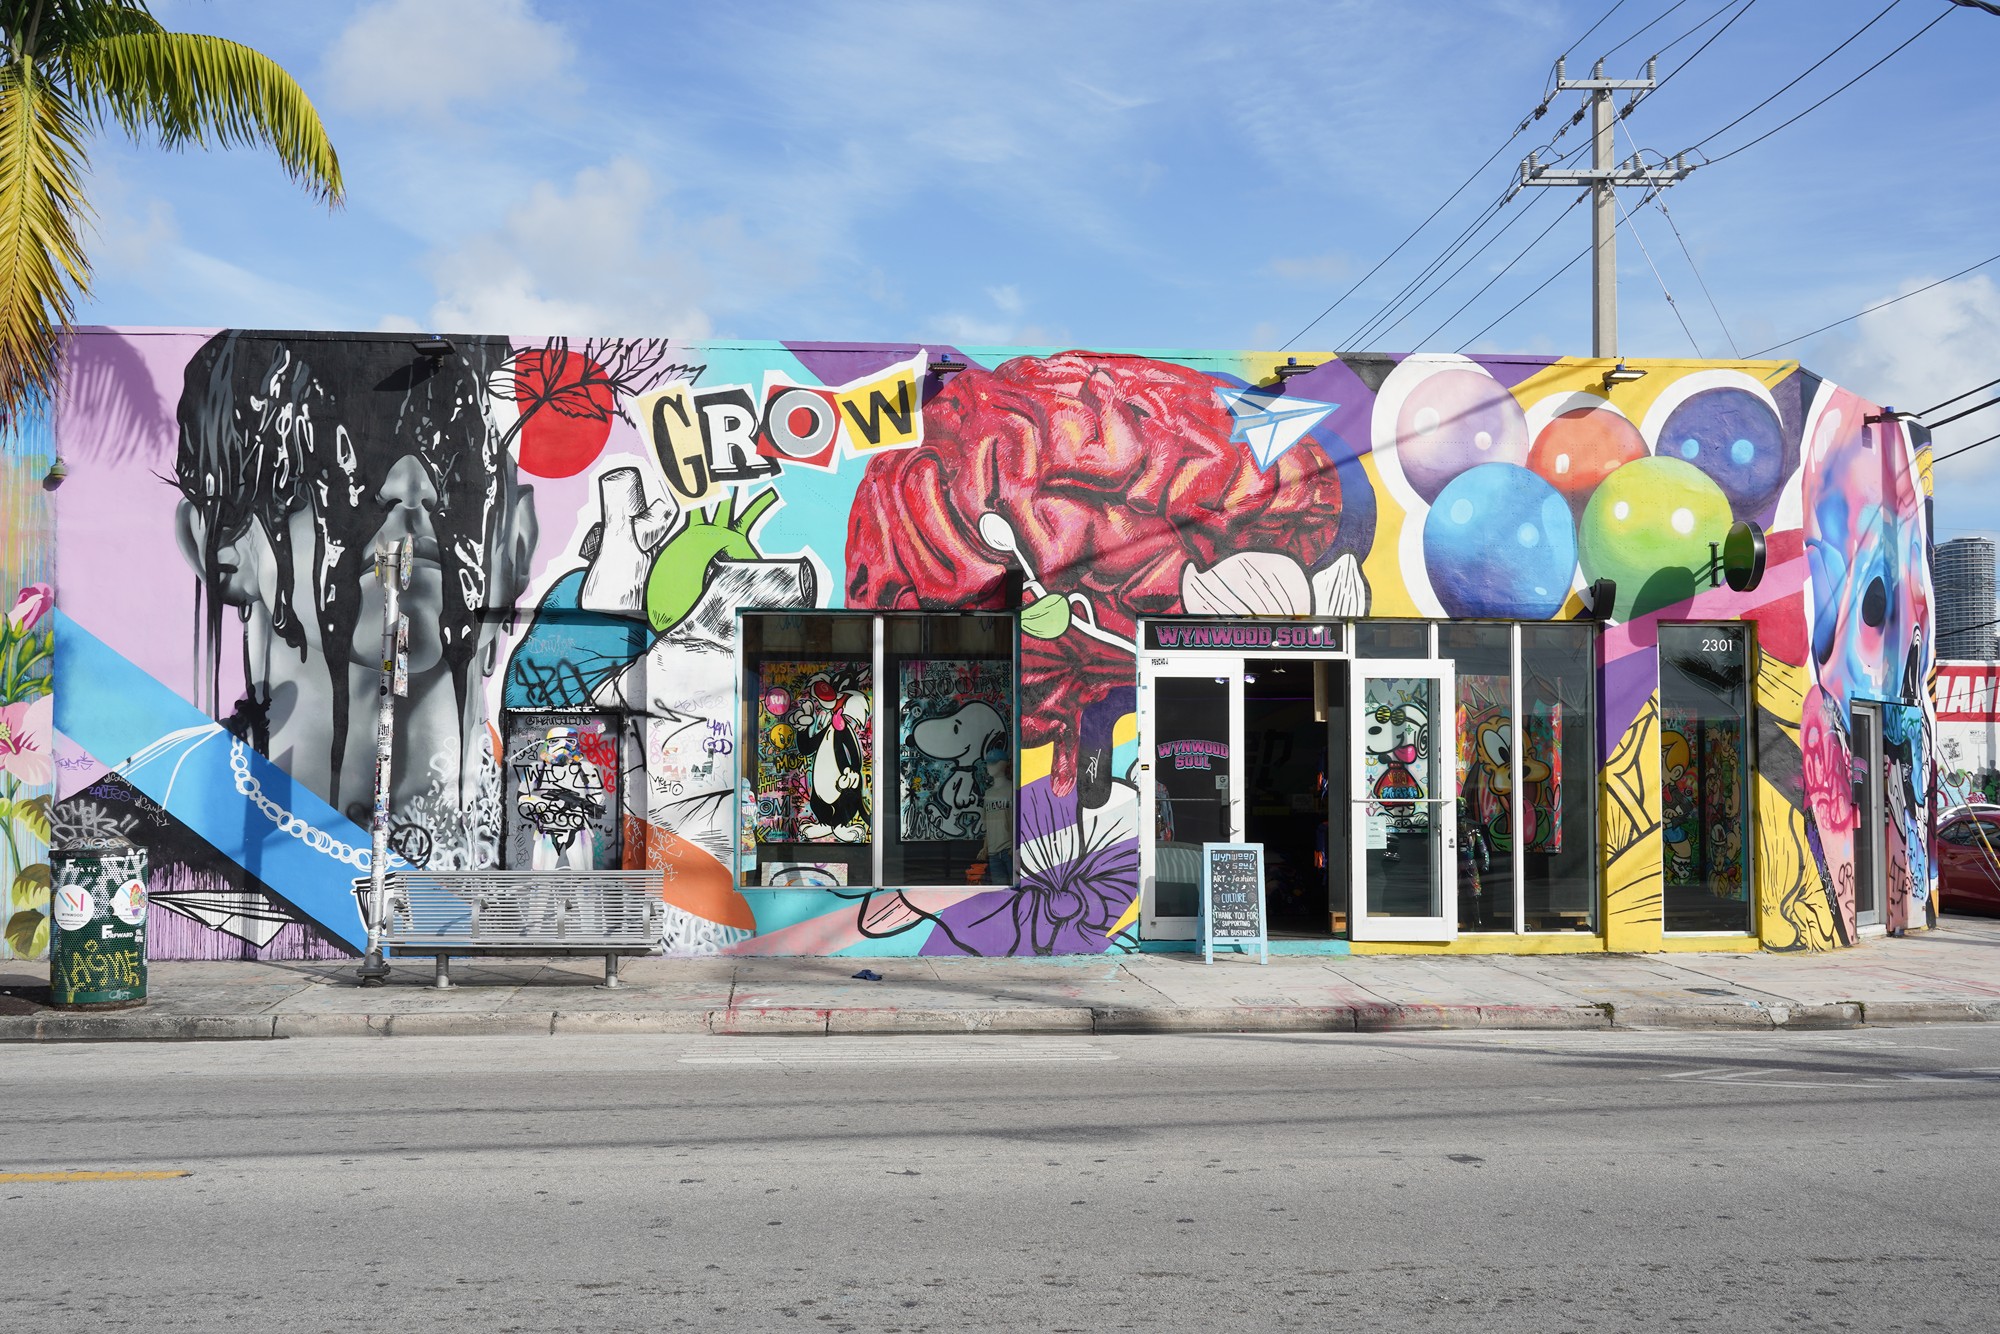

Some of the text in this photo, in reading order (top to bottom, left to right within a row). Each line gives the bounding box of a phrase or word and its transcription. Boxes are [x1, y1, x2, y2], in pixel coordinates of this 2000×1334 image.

[652, 380, 913, 498] GROW
[1155, 626, 1336, 649] WYNWOOD SOUL
[1702, 639, 1733, 652] 2301
[907, 676, 1002, 699] SNOOPY
[1936, 675, 2000, 713] AN
[1157, 740, 1229, 759] WYNWOOD
[1175, 755, 1211, 770] SOUL
[1213, 875, 1226, 883] ART
[1221, 893, 1247, 903] CULTURE
[1215, 911, 1258, 920] THANK YOU FOR
[1230, 929, 1256, 937] BUSINESS
